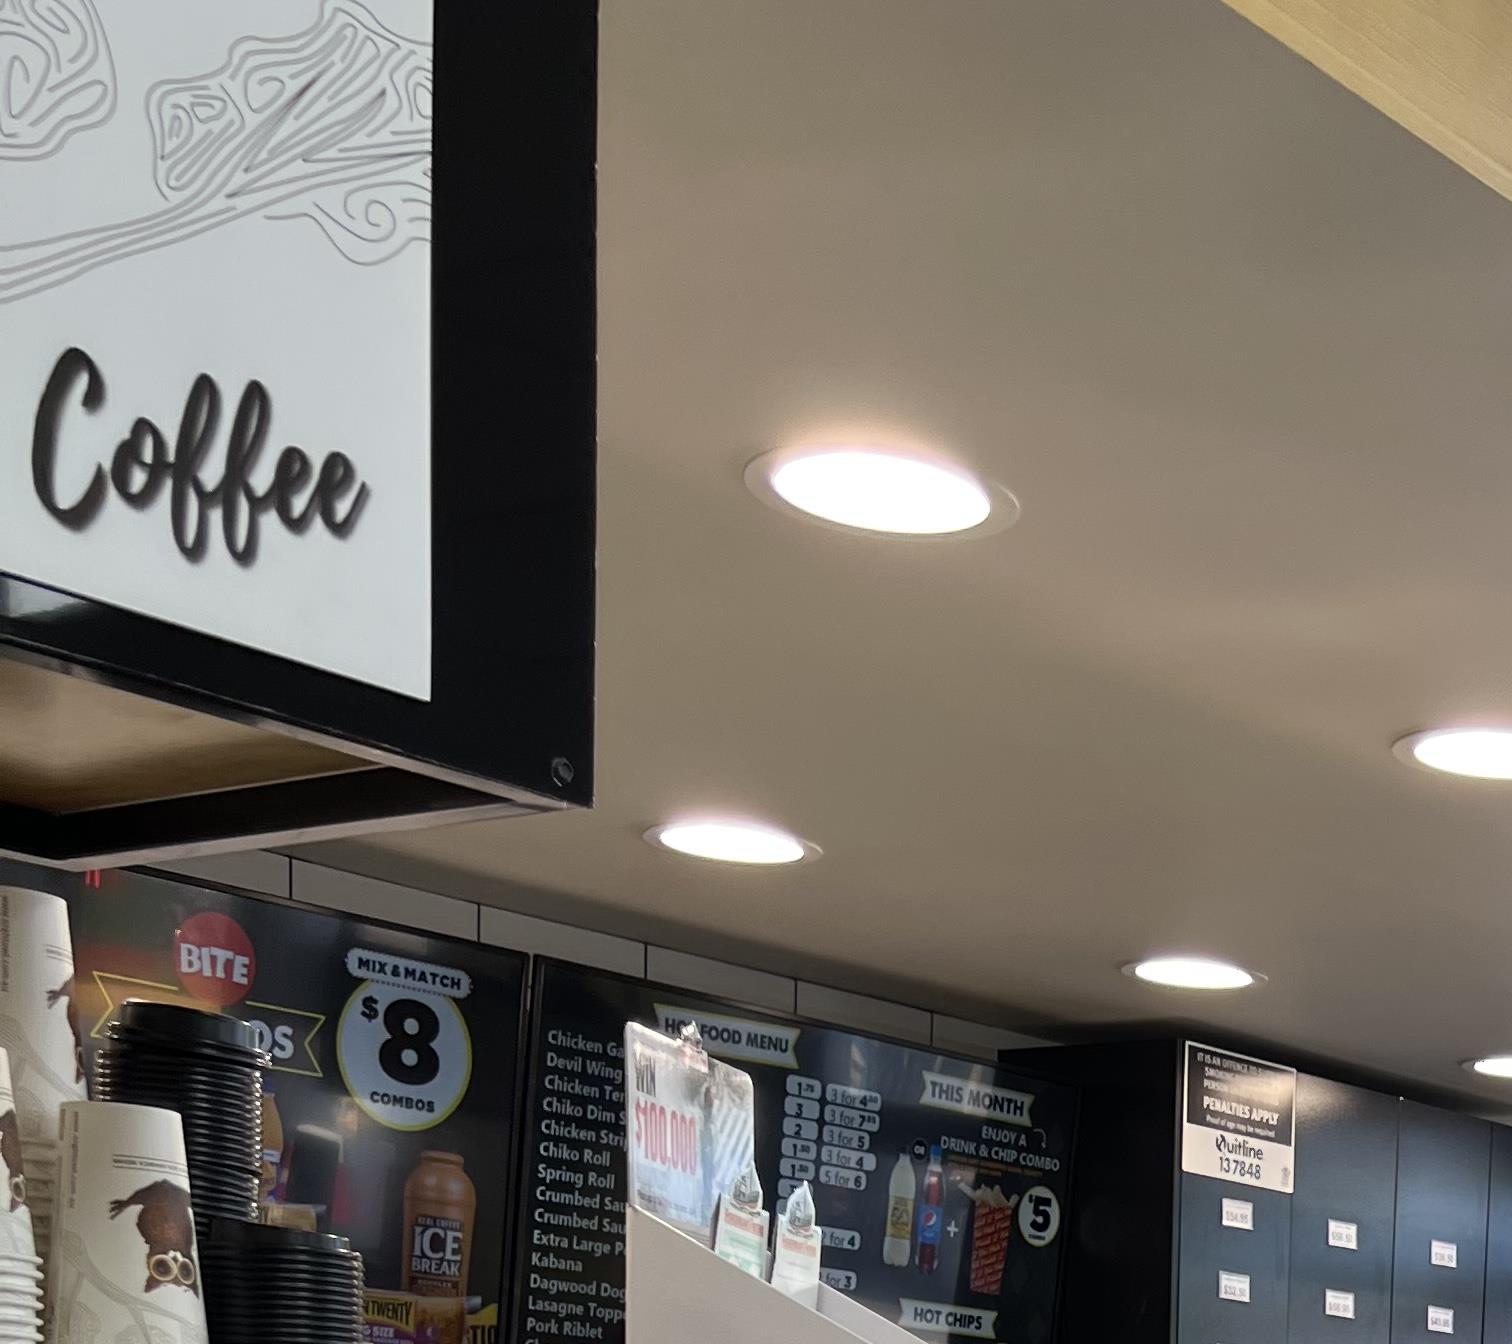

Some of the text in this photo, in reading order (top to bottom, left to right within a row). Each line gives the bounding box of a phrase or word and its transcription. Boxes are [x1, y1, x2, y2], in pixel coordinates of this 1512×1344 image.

[32, 346, 368, 566] Coffee
[180, 943, 250, 985] BITE
[357, 957, 461, 991] MIX & MATCH
[360, 995, 440, 1086] $8
[548, 1030, 602, 1054] Chicken
[702, 1024, 789, 1053] FOOD MENU
[546, 1052, 582, 1074] Devil
[544, 1075, 600, 1099] Chicken
[840, 1089, 856, 1103] for
[929, 1080, 1025, 1117] THIS MONTH
[370, 1091, 435, 1113] COMBOS
[543, 1097, 615, 1124] Chiko Dim
[1203, 1095, 1280, 1126] PENALTIES APPLY
[839, 1110, 855, 1125] for
[541, 1119, 596, 1143] Chicken
[837, 1131, 865, 1148] for 5
[982, 1126, 1027, 1147] ENJOY A
[540, 1142, 610, 1168] Chiko Roll
[940, 1136, 1060, 1172] DRINK & CHIP COMBO
[1215, 1133, 1264, 1161] Quitline
[835, 1151, 864, 1168] for 4
[537, 1164, 615, 1190] Spring Roll
[834, 1171, 862, 1188] for 6
[536, 1186, 600, 1209] Crumbed
[534, 1207, 598, 1231] Crumbed
[533, 1229, 611, 1257] Extra Large
[829, 1231, 855, 1248] for 4
[531, 1252, 583, 1273] Kabana
[530, 1273, 596, 1296] Dagwood
[528, 1296, 584, 1317] Lasagne
[913, 1306, 983, 1330] HOT CHIPS
[526, 1317, 603, 1339] Pork Riblet
